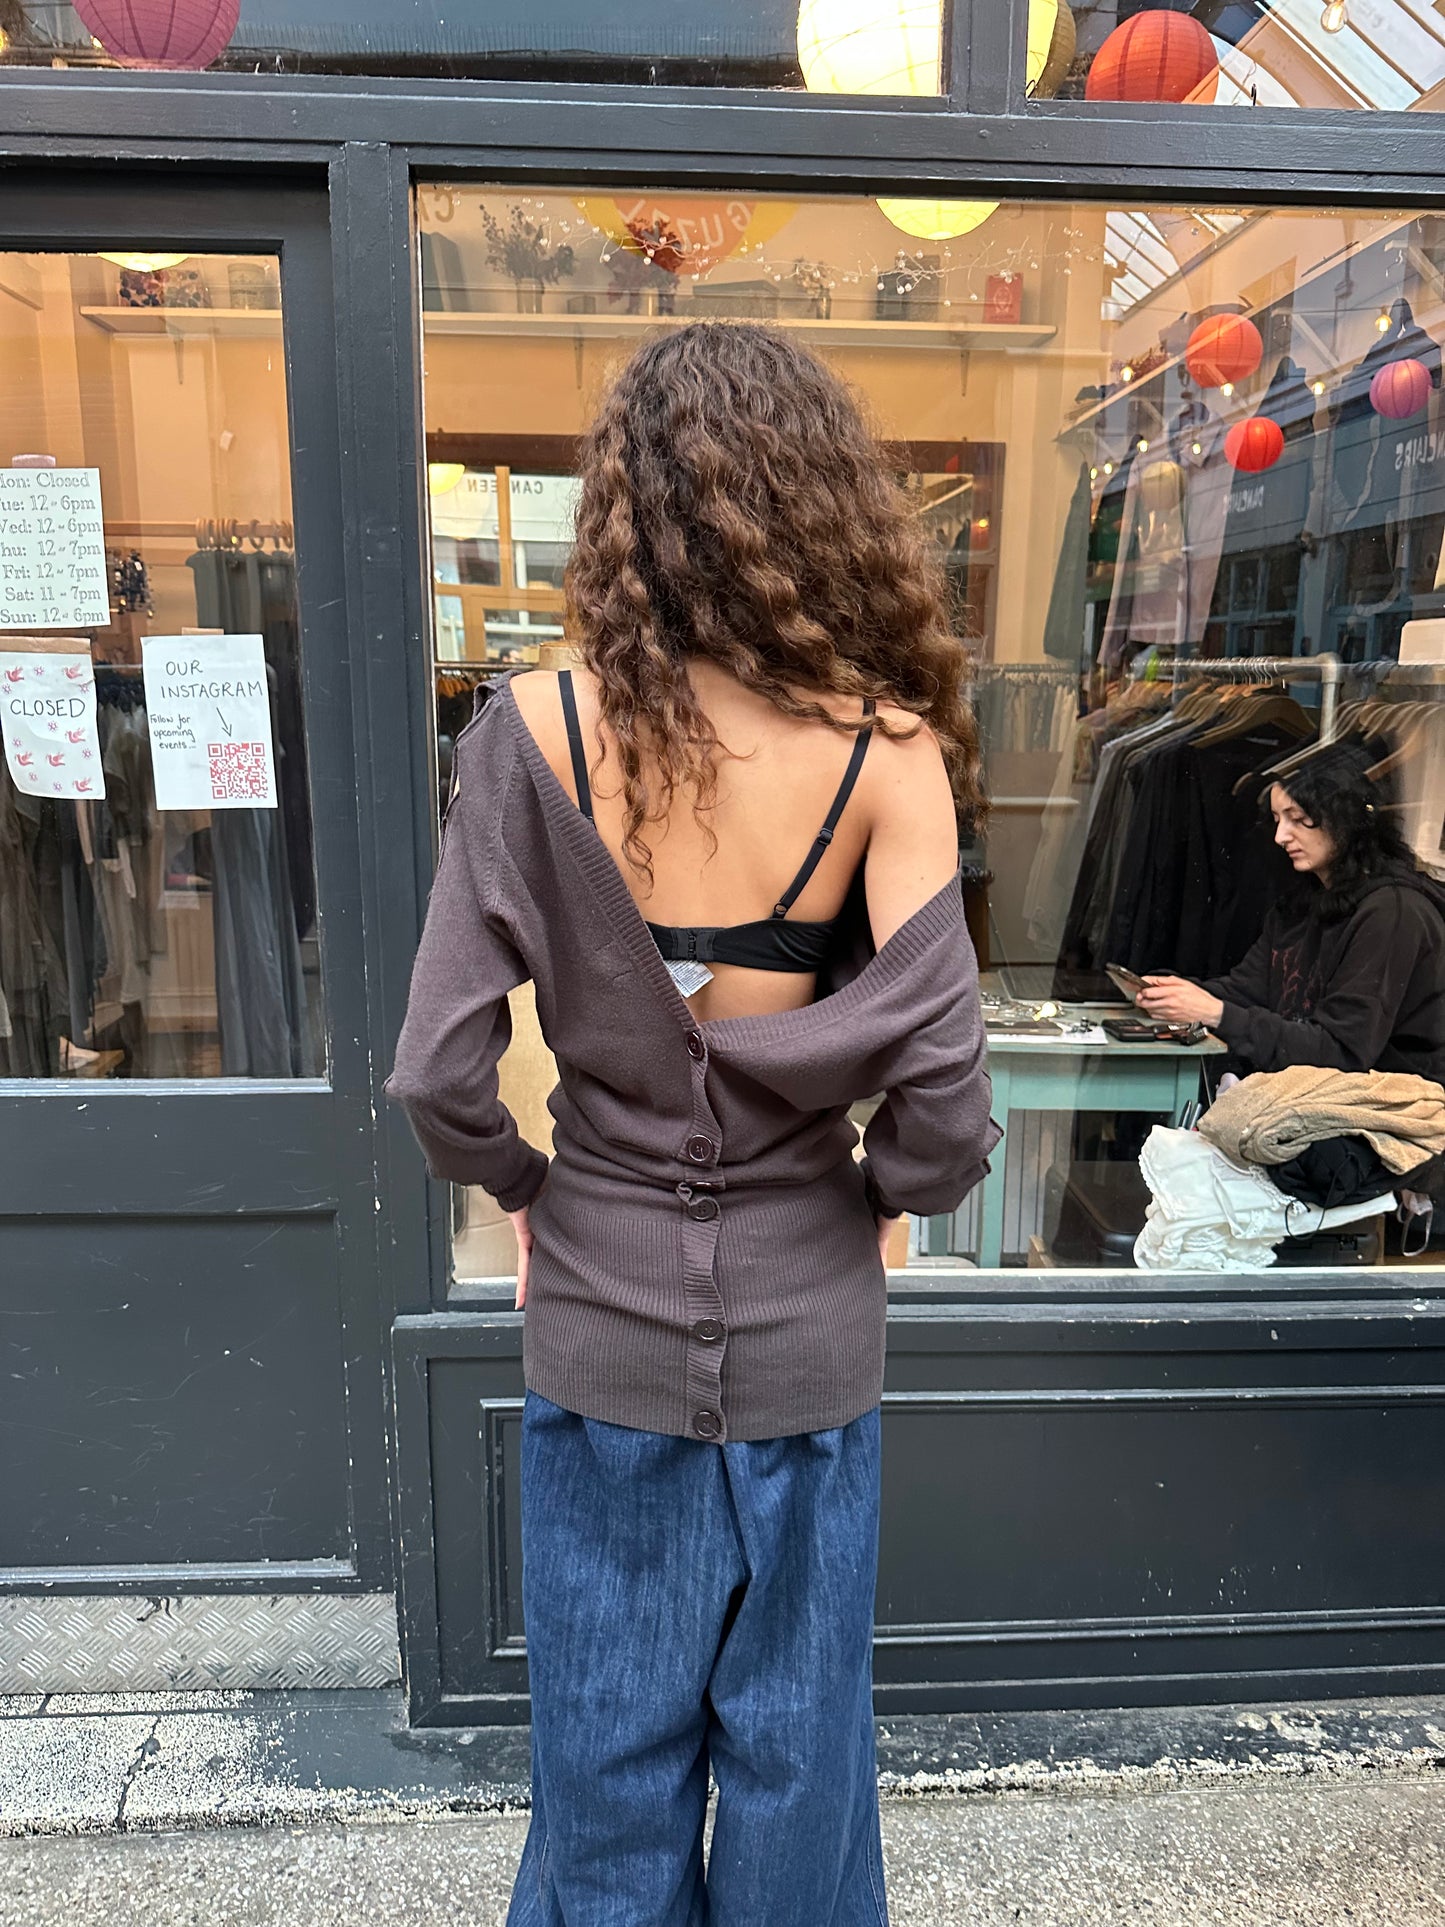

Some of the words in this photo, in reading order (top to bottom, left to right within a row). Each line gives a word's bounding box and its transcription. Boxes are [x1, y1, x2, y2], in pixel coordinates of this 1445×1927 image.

[0, 473, 30, 488] on:
[36, 472, 90, 488] Closed
[0, 498, 25, 511] ue:
[30, 494, 48, 511] 12
[61, 495, 96, 514] 6pm
[37, 518, 55, 534] 12
[68, 518, 101, 537] 6pm
[0, 541, 27, 557] hu:
[38, 540, 56, 556] 12
[69, 540, 101, 559] 7pm
[2, 564, 31, 579] Fri:
[36, 562, 54, 578] 12
[68, 564, 99, 582] 7pm
[5, 587, 34, 601] Sat:
[40, 587, 55, 601] 11
[70, 586, 101, 604] 7pm
[0, 609, 37, 623] Sun:
[43, 607, 60, 623] 12
[73, 608, 105, 626] 6pm
[165, 659, 204, 676] OUR
[161, 681, 263, 698] INSTAGRAM
[10, 698, 86, 718] CLOSED
[150, 713, 174, 724] Follow
[176, 713, 191, 730] for
[153, 728, 196, 743] upcoming
